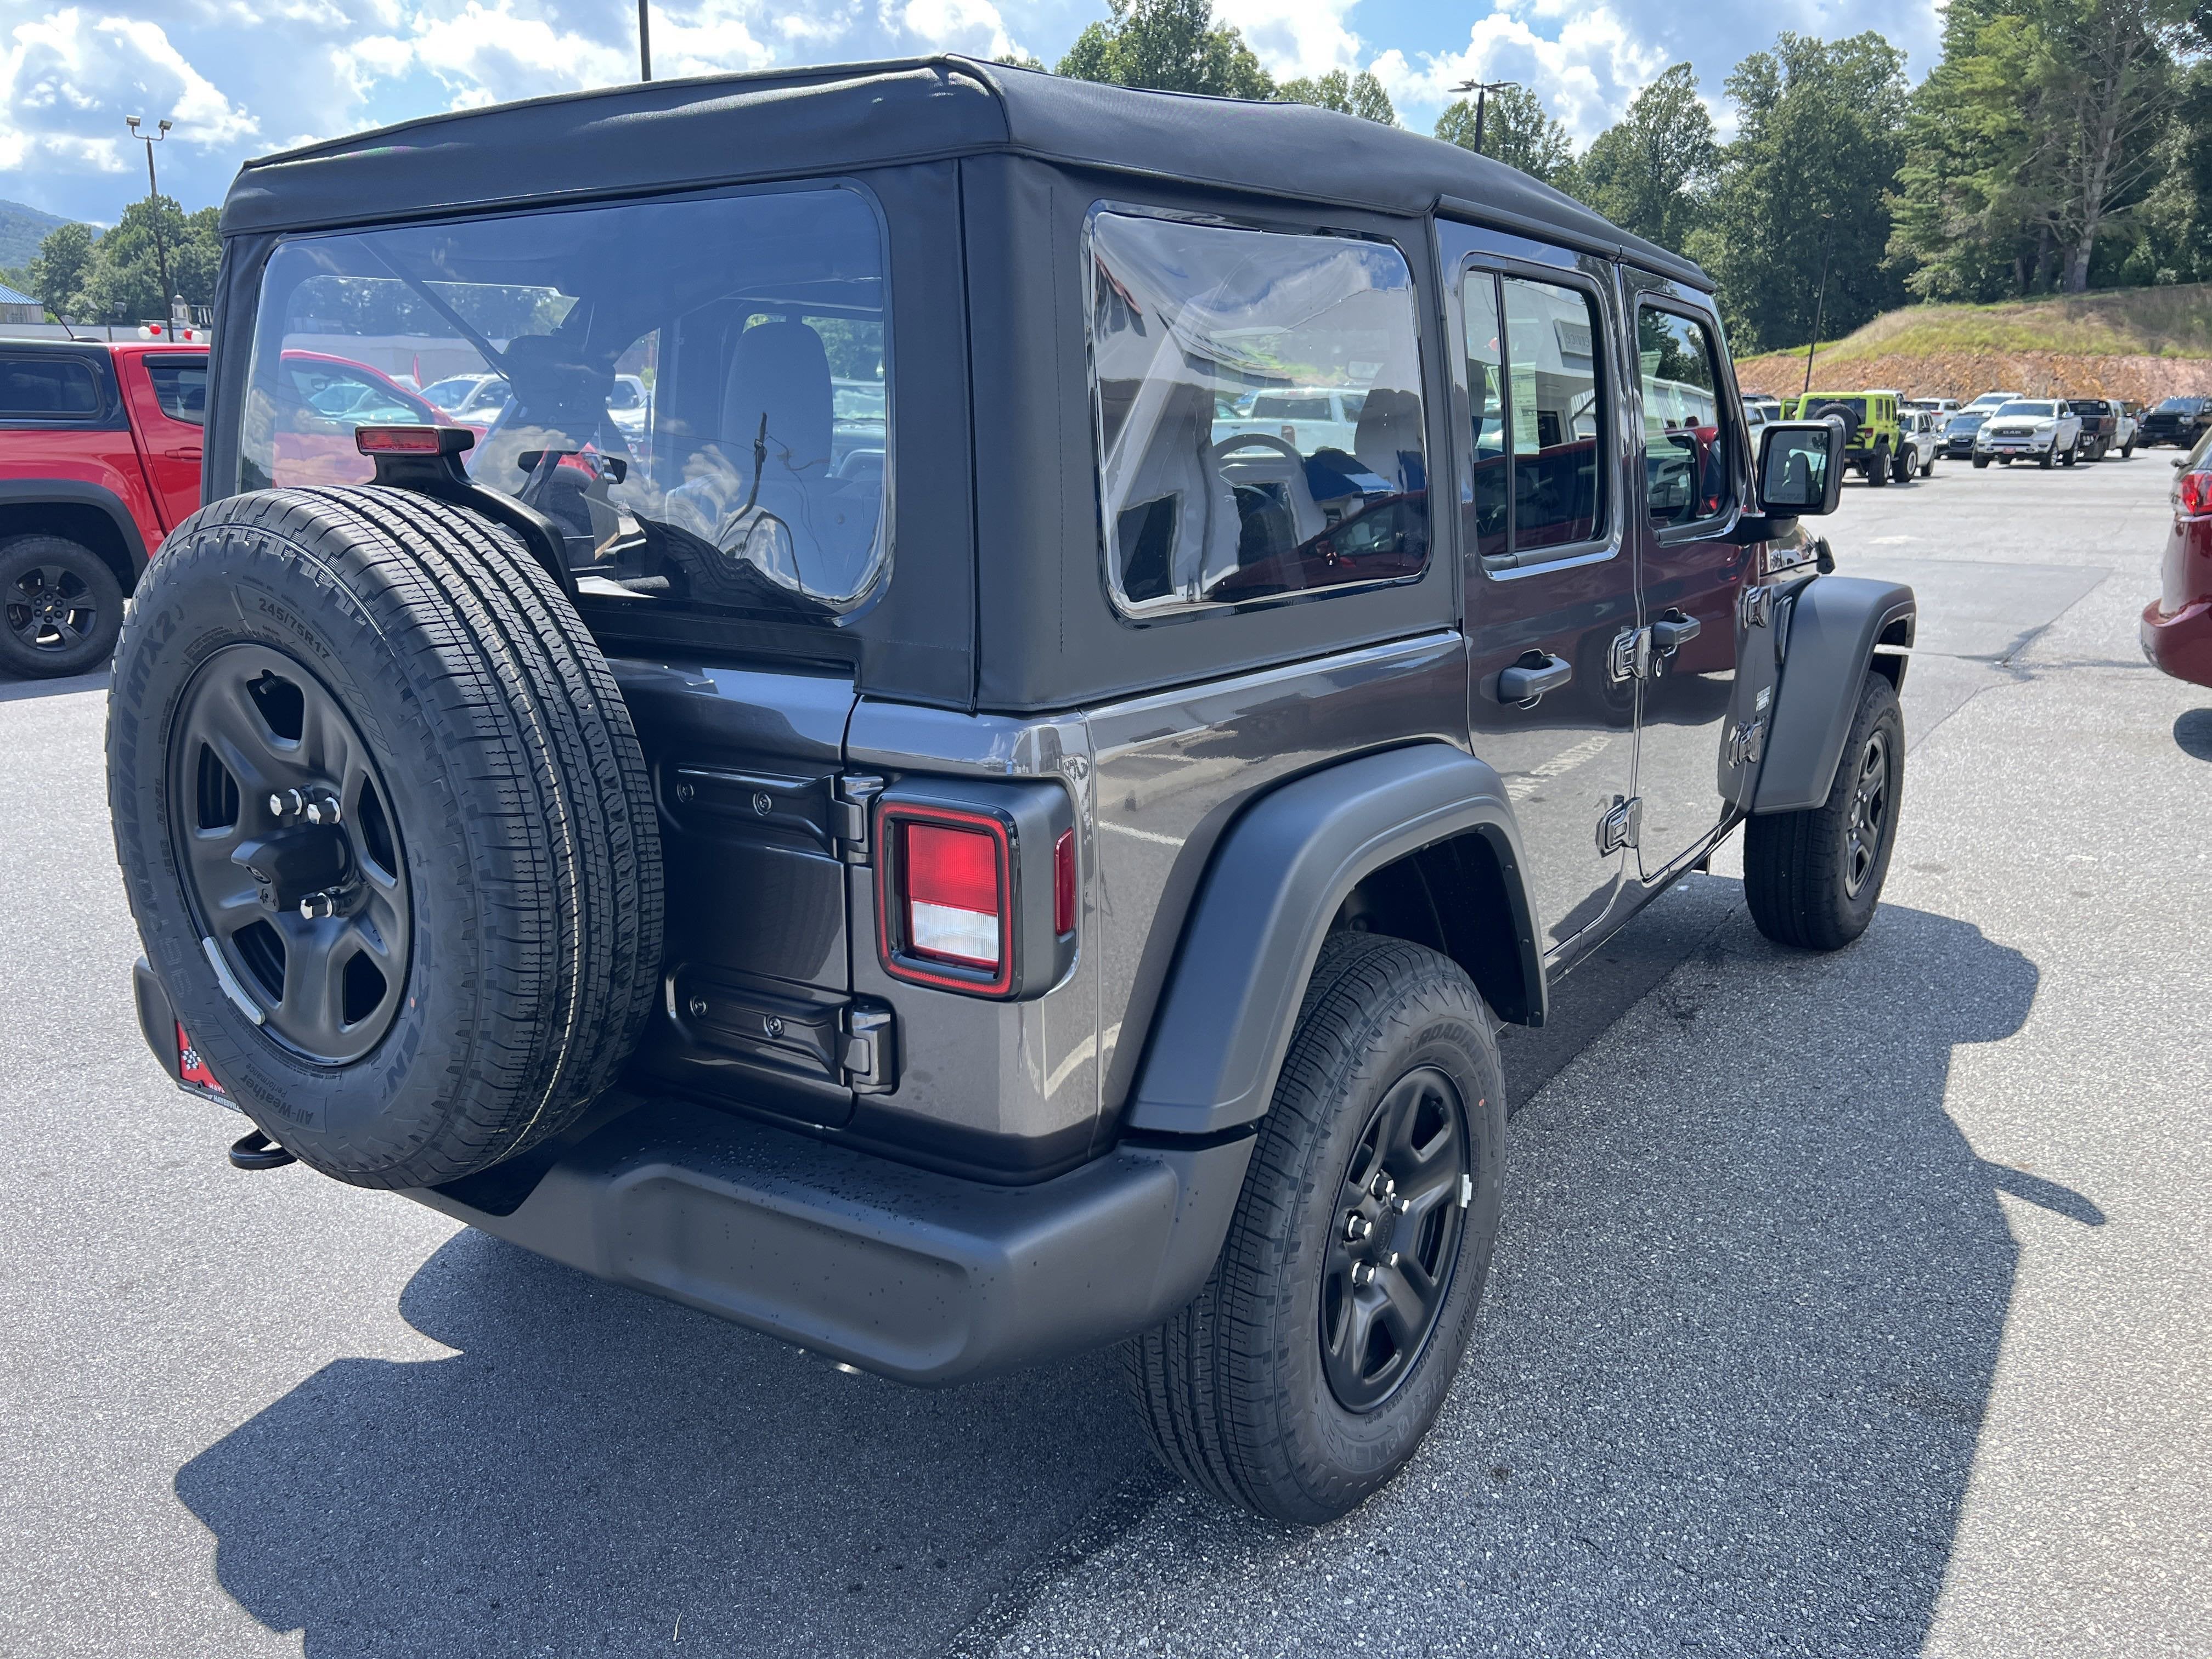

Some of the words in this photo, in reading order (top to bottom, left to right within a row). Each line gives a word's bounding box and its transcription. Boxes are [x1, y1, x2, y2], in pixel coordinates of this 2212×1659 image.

[258, 597, 330, 659] 245/75R17
[127, 610, 176, 709] HTX2
[240, 1075, 314, 1125] All-Weather
[246, 1063, 287, 1098] Performance
[1455, 1260, 1482, 1346] 245/75R17
